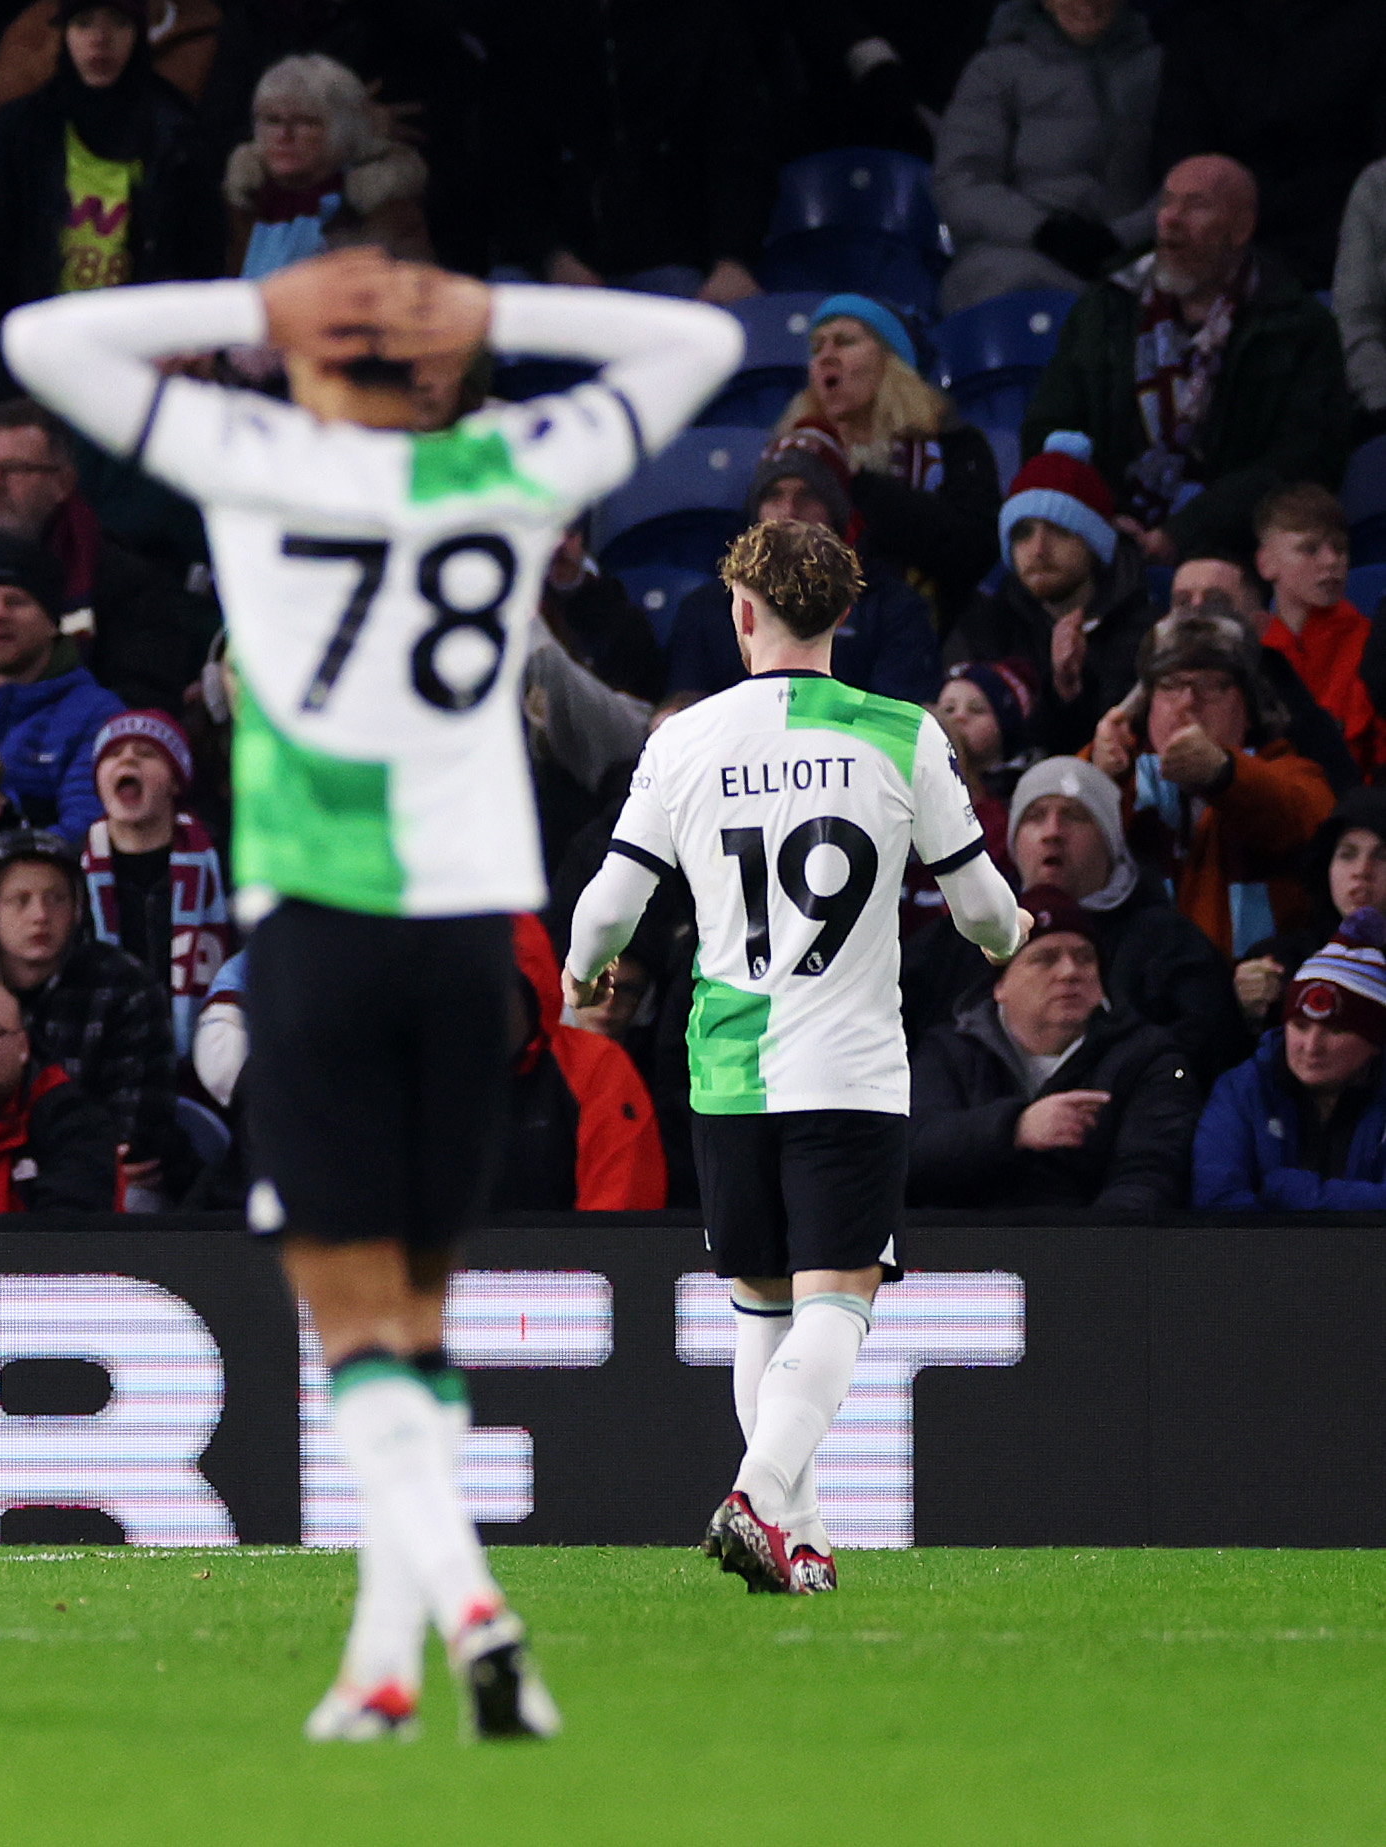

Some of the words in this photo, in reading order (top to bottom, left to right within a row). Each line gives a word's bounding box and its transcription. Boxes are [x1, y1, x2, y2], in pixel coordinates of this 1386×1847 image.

[281, 532, 517, 713] 78
[720, 757, 856, 797] ELLIOTT
[720, 815, 879, 980] 19
